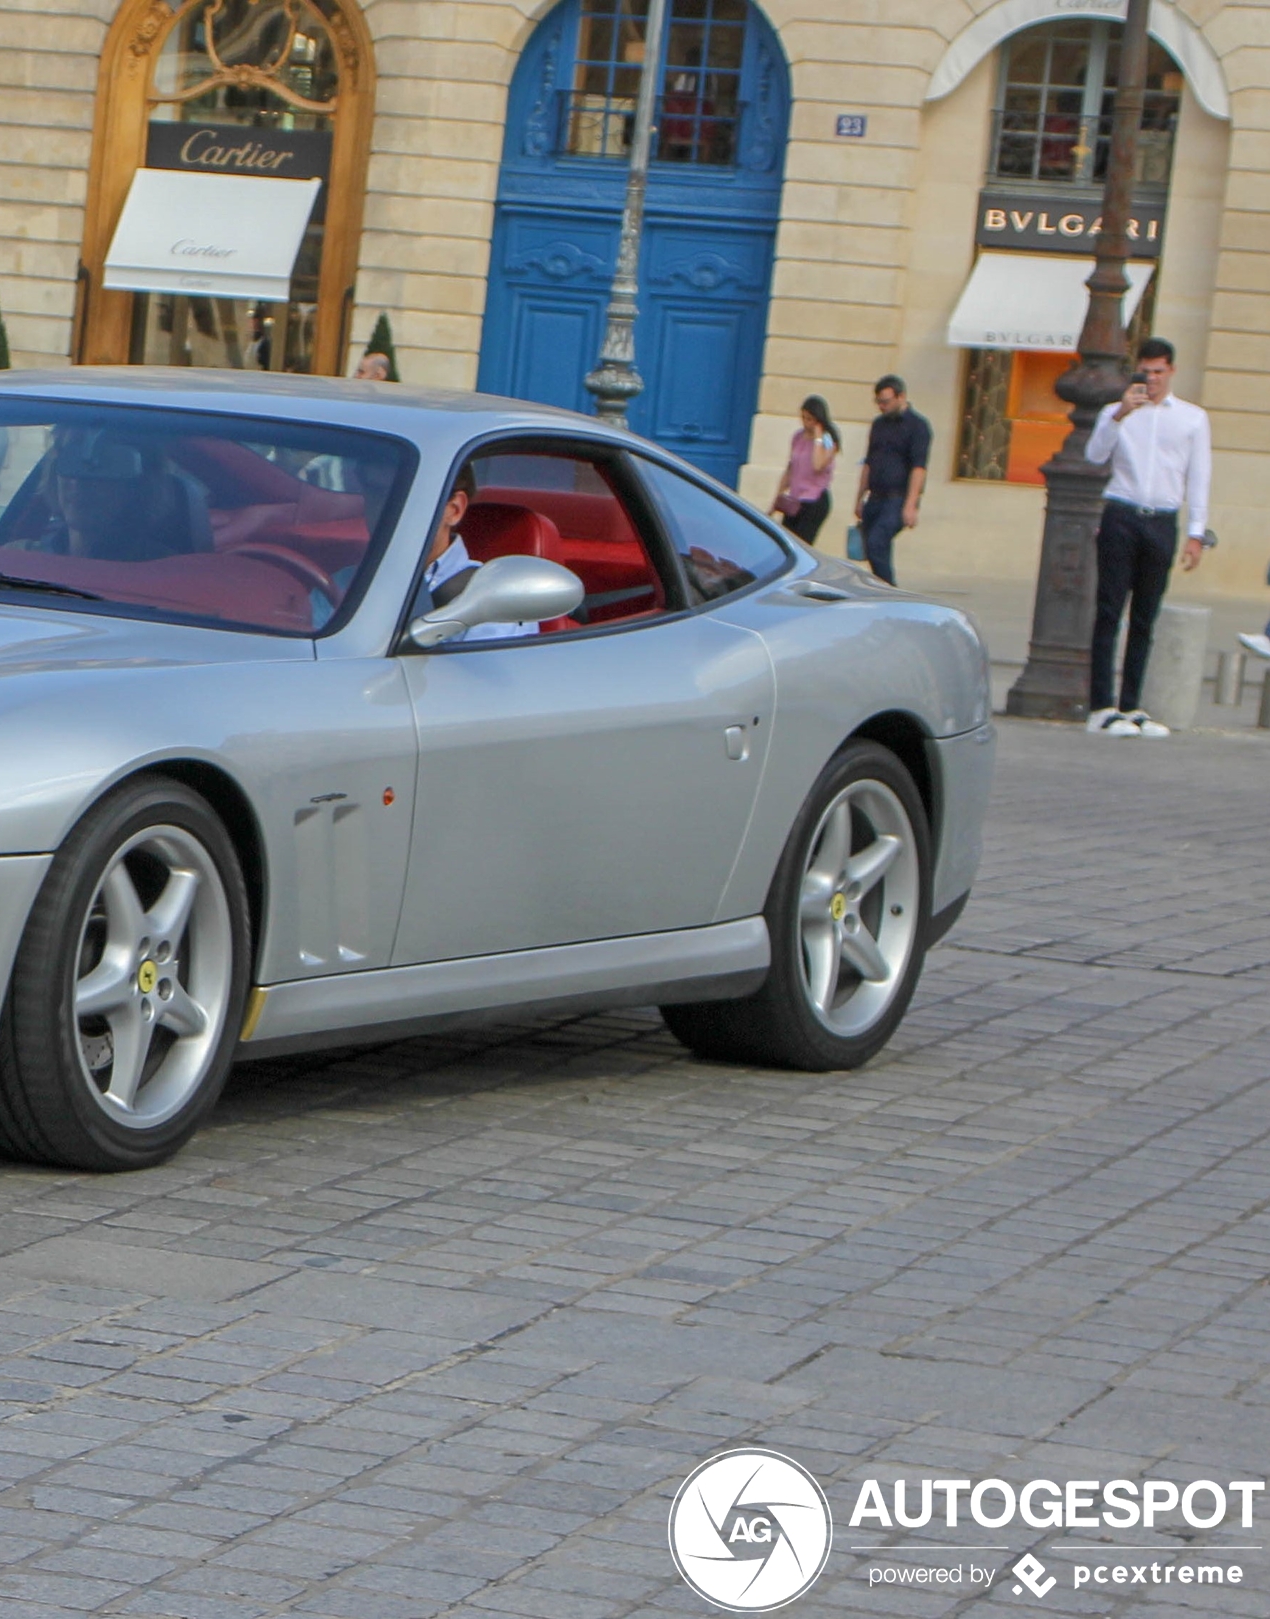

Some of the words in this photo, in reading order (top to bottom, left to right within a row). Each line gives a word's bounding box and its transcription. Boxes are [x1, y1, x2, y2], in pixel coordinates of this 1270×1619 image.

[840, 117, 861, 134] 23
[180, 129, 295, 169] Cartier
[170, 238, 237, 258] Cartier
